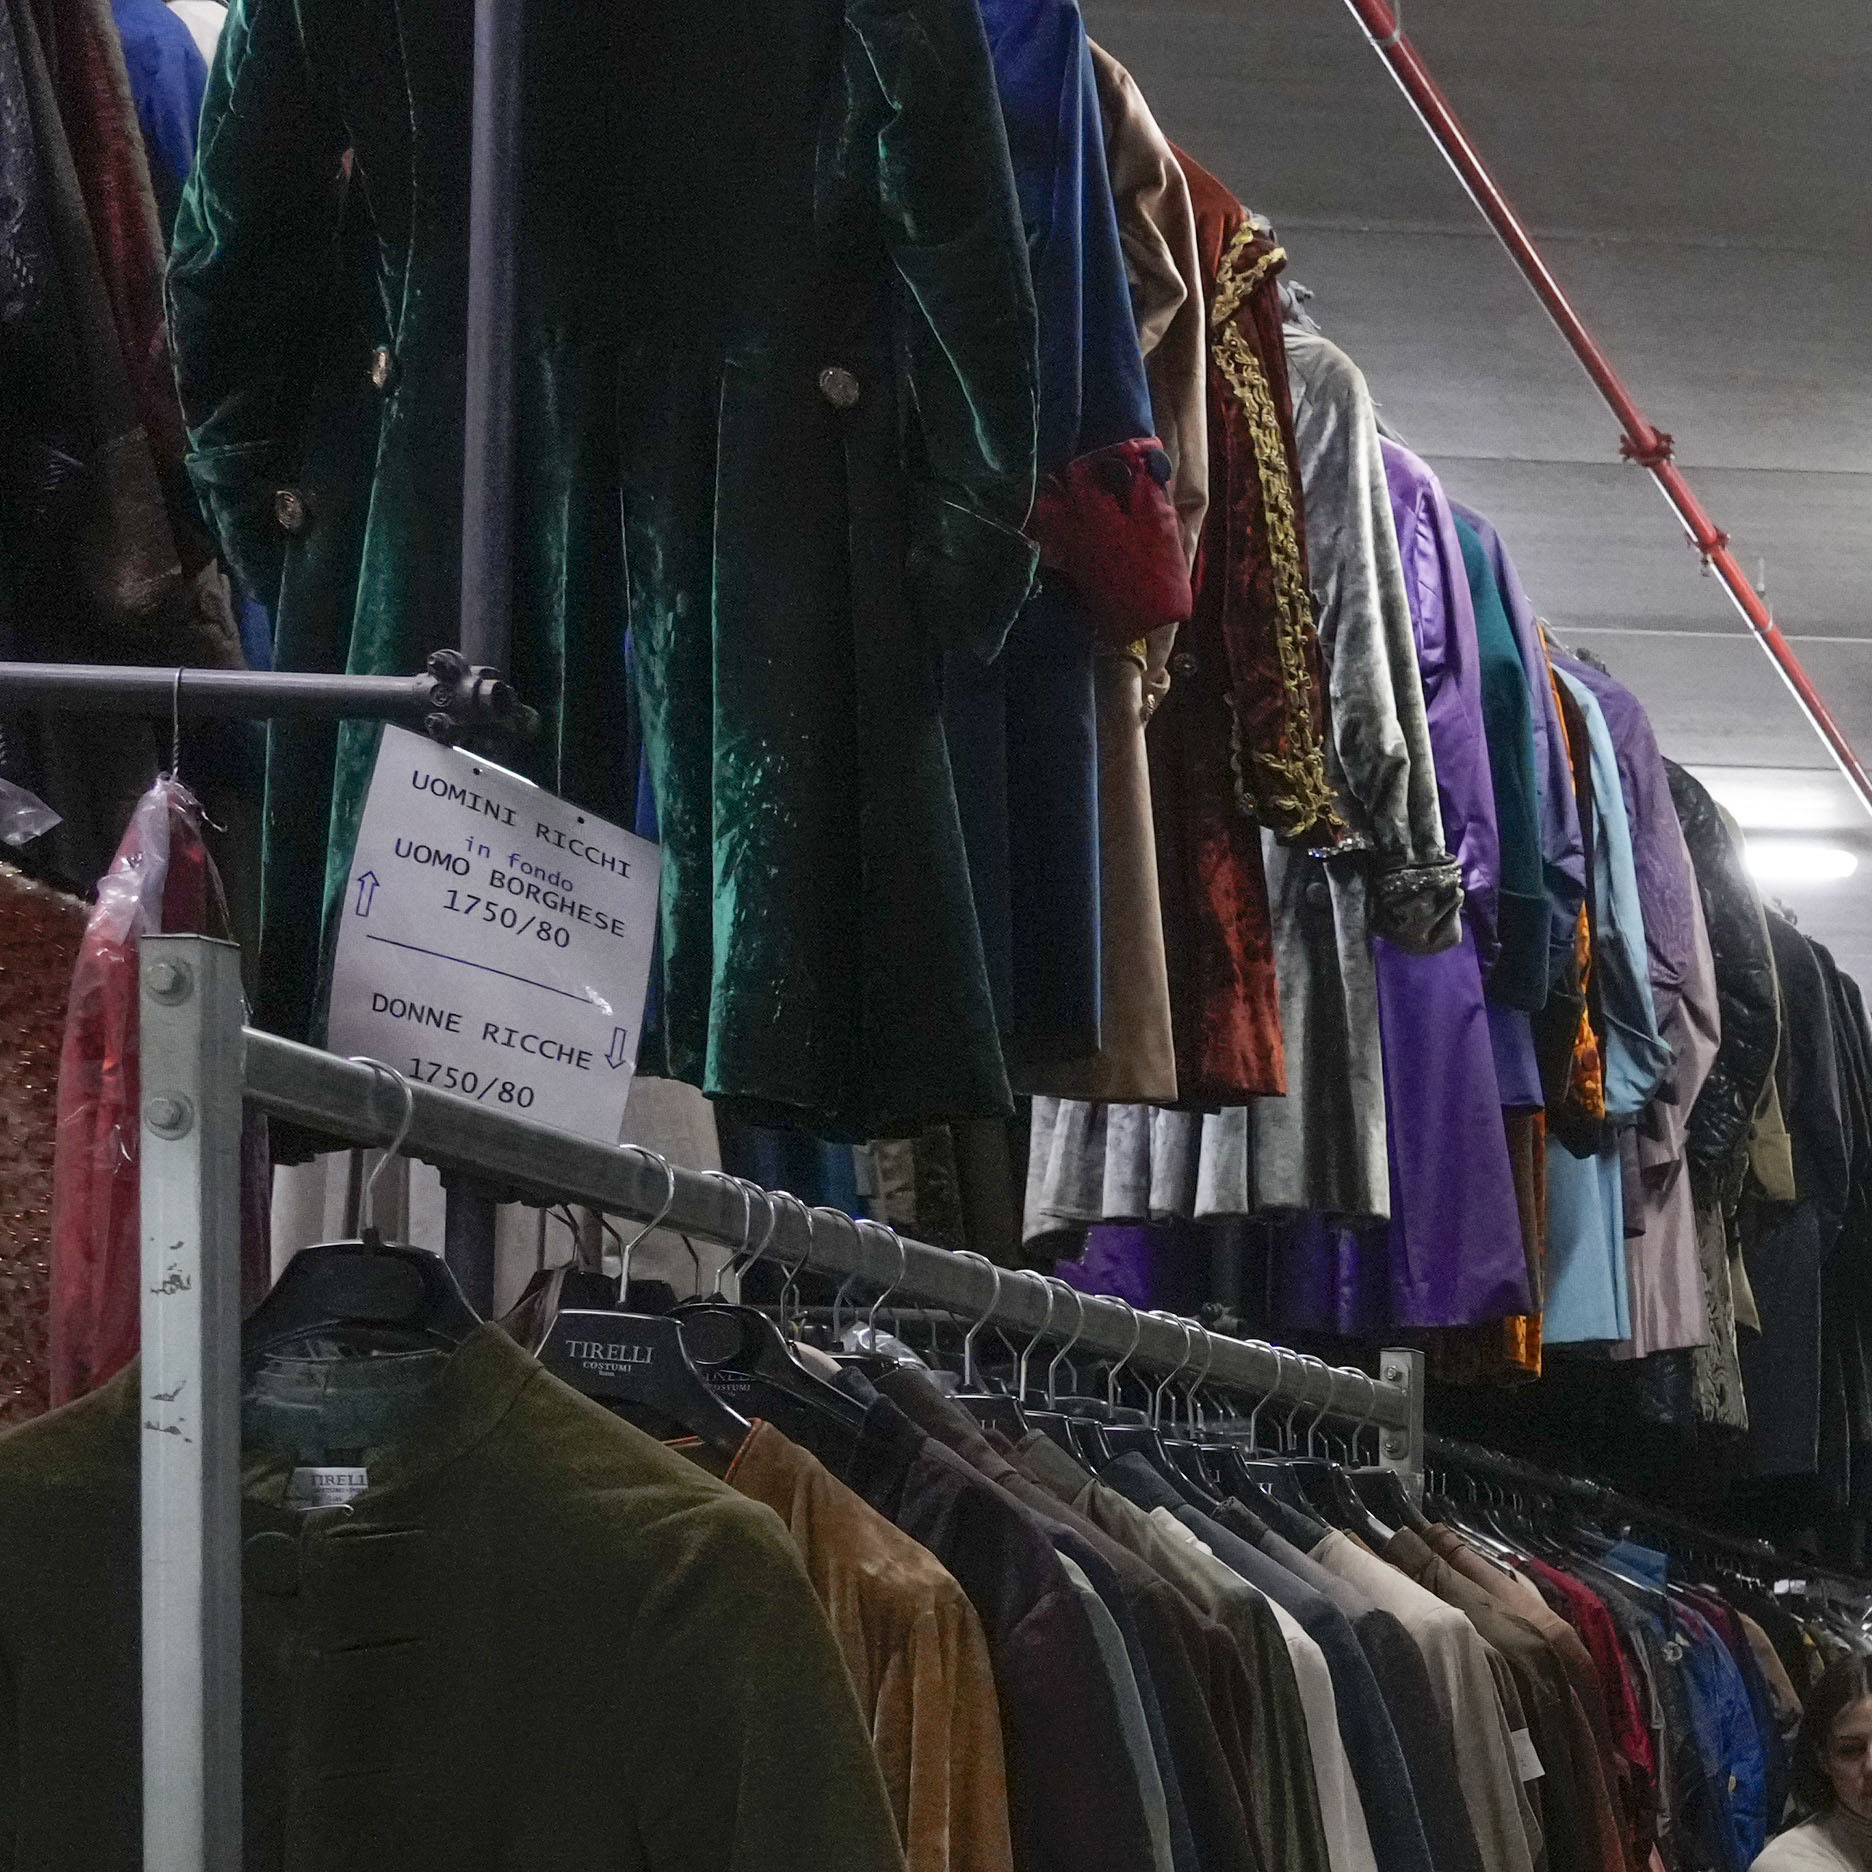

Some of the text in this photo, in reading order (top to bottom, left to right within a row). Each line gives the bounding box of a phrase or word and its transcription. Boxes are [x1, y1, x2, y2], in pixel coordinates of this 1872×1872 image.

[412, 770, 631, 879] UOMINI RICCHI
[395, 838, 625, 938] UOMO BORGHESE
[465, 836, 574, 892] in fondo
[443, 890, 570, 948] 1750/80
[372, 992, 593, 1071] DONNE RICCHE
[408, 1057, 535, 1109] 1750/80
[566, 1340, 654, 1364] TIRELLI
[583, 1361, 632, 1373] COSTUMI
